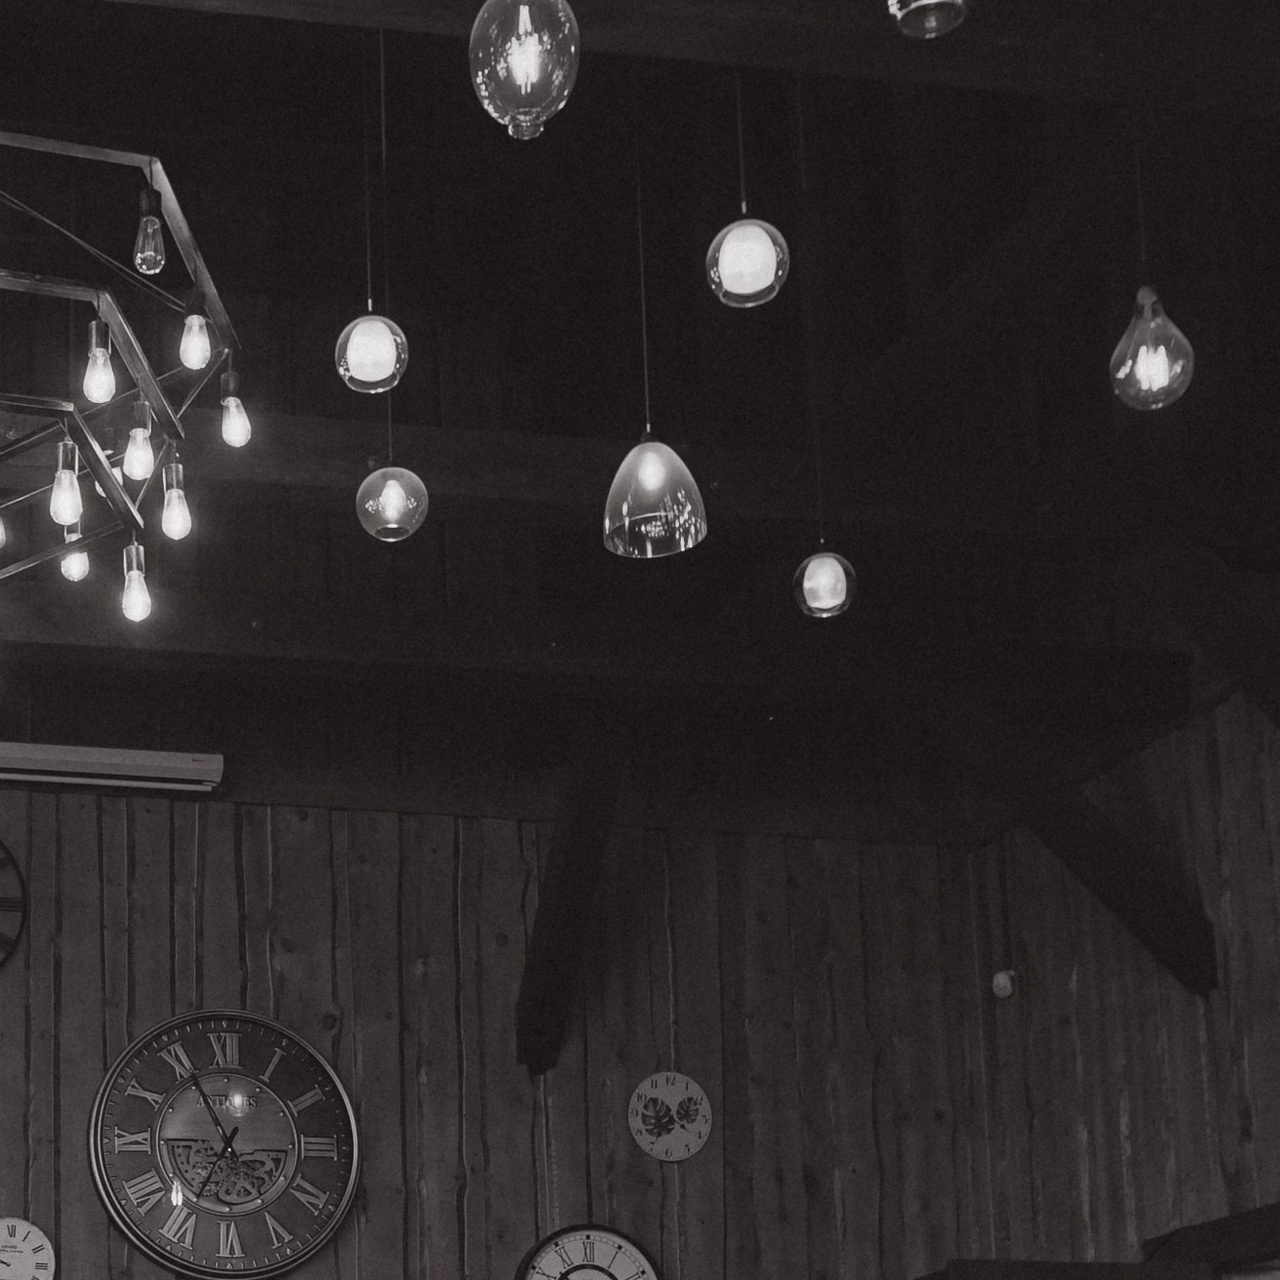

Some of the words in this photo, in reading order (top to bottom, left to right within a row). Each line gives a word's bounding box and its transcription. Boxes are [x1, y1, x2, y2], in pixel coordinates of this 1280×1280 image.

[158, 1041, 199, 1082] XI
[207, 1032, 242, 1069] XII
[260, 1048, 286, 1082] I
[651, 1080, 657, 1088] 11
[666, 1076, 675, 1085] 12
[125, 1078, 167, 1111] X
[196, 1095, 257, 1108] ANTIQES
[288, 1085, 326, 1116] II
[637, 1093, 647, 1102] 10
[114, 1126, 151, 1155] IX
[300, 1134, 338, 1160] III
[666, 1148, 672, 1158] 6
[123, 1168, 166, 1216] VIII
[291, 1173, 330, 1215] IV
[22, 1231, 30, 1241] I
[159, 1205, 197, 1250] VII
[215, 1221, 245, 1258] VI
[265, 1212, 294, 1249] V
[32, 1245, 44, 1254] II
[555, 1247, 573, 1269] XI
[583, 1242, 594, 1262] XII
[608, 1251, 619, 1268] I
